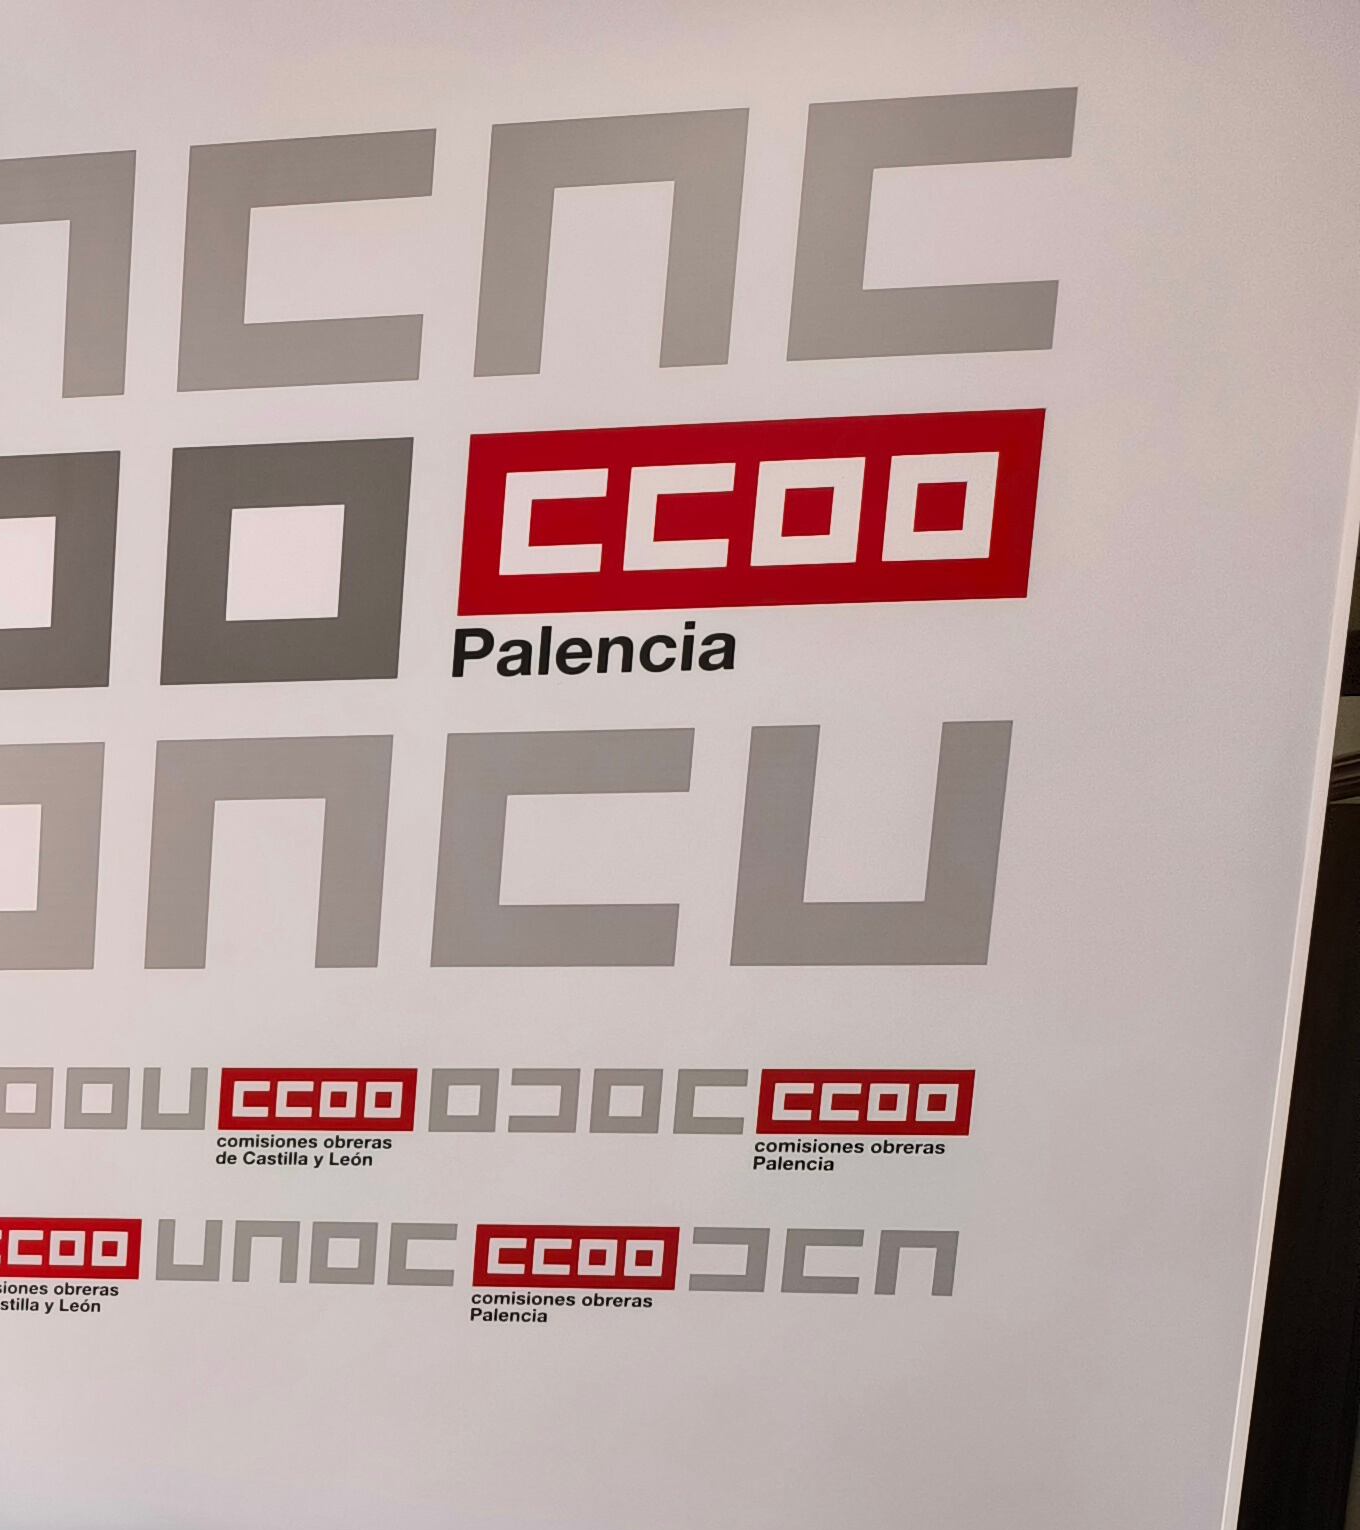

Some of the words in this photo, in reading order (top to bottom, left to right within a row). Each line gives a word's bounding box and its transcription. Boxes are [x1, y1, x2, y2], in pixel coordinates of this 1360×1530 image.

[452, 621, 736, 678] Palencia
[217, 1134, 317, 1149] comisiones
[324, 1135, 392, 1150] obreras
[755, 1138, 864, 1155] comisiones
[870, 1139, 945, 1155] obreras
[216, 1152, 237, 1165] de
[242, 1151, 309, 1166] Castilla
[313, 1156, 323, 1169] y
[329, 1151, 373, 1167] León
[752, 1156, 834, 1172] Palencia
[54, 1282, 119, 1297] obreras
[44, 1302, 54, 1314] y
[59, 1297, 101, 1313] León
[471, 1291, 575, 1306] comisiones
[581, 1293, 653, 1308] obreras
[470, 1308, 548, 1323] Palencia
